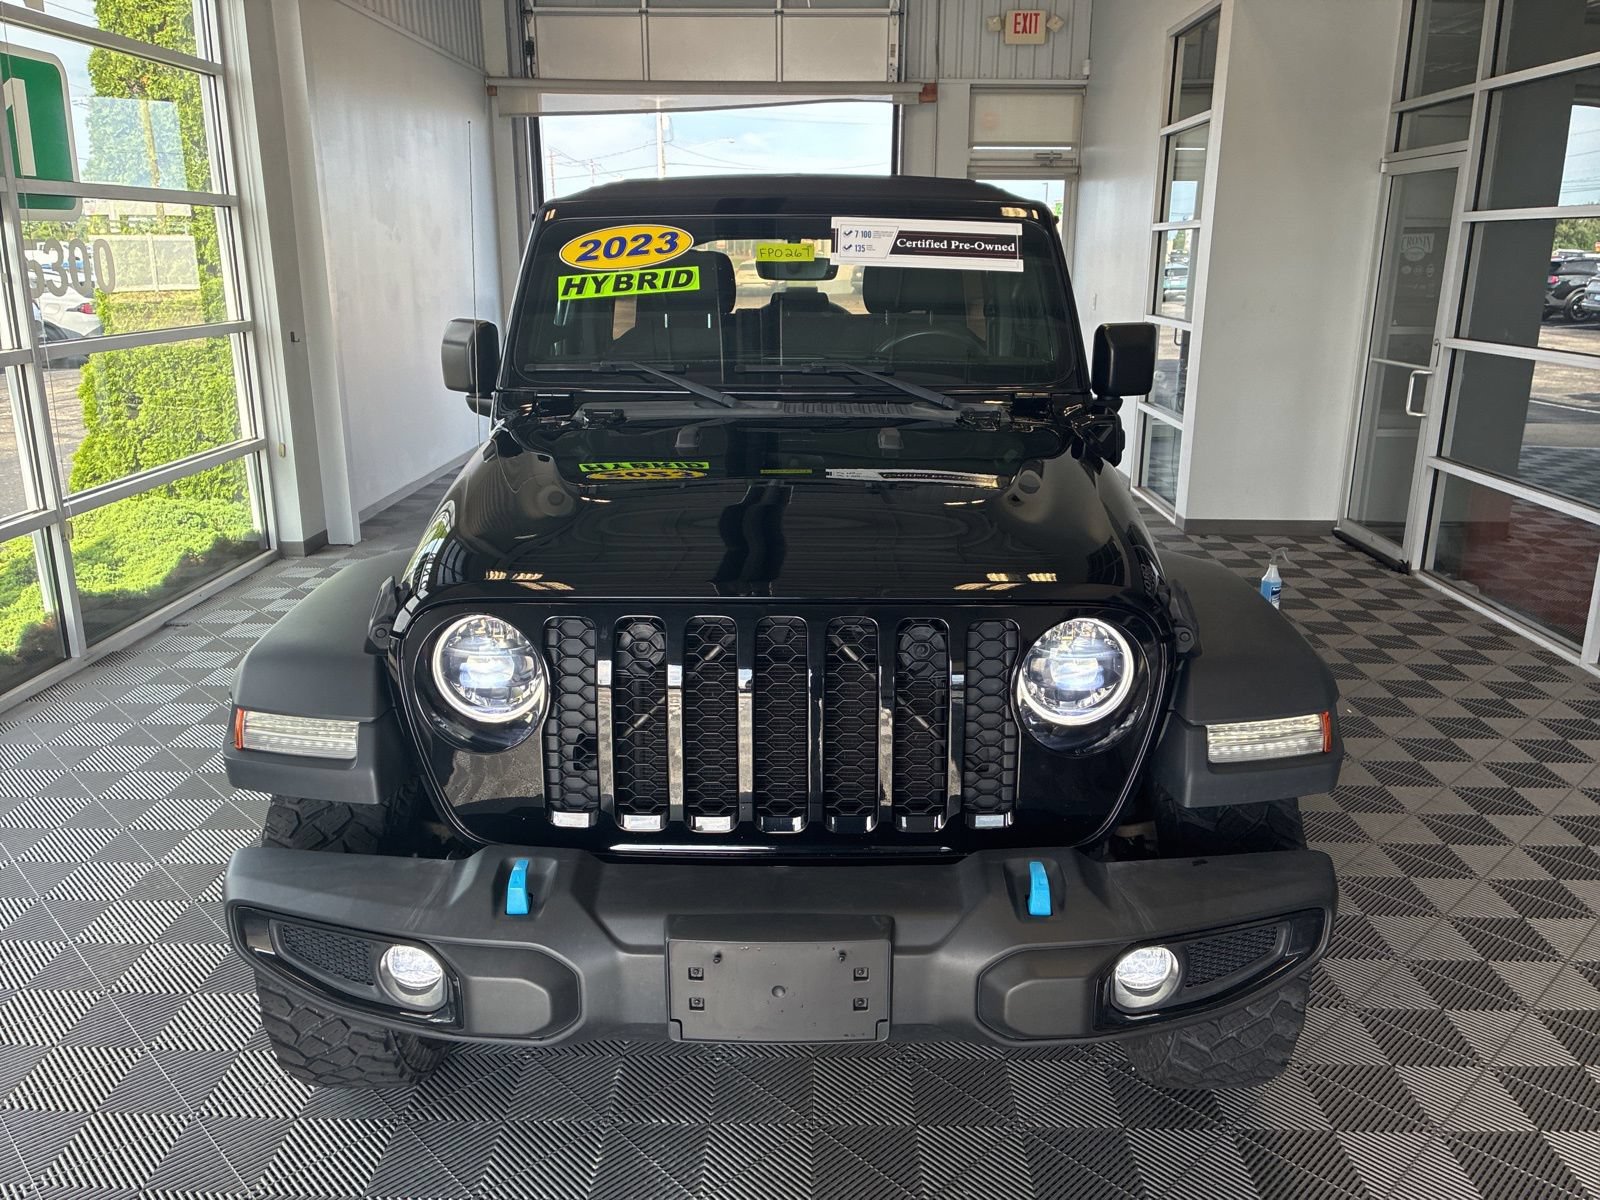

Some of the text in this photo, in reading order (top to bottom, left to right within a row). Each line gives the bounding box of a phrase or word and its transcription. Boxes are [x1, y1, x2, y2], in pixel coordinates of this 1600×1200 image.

[1014, 13, 1040, 34] EXIT
[575, 231, 679, 263] 2023
[855, 244, 866, 253] 135
[896, 238, 1016, 253] Certified Pre-Owned
[561, 269, 694, 297] HYBRID
